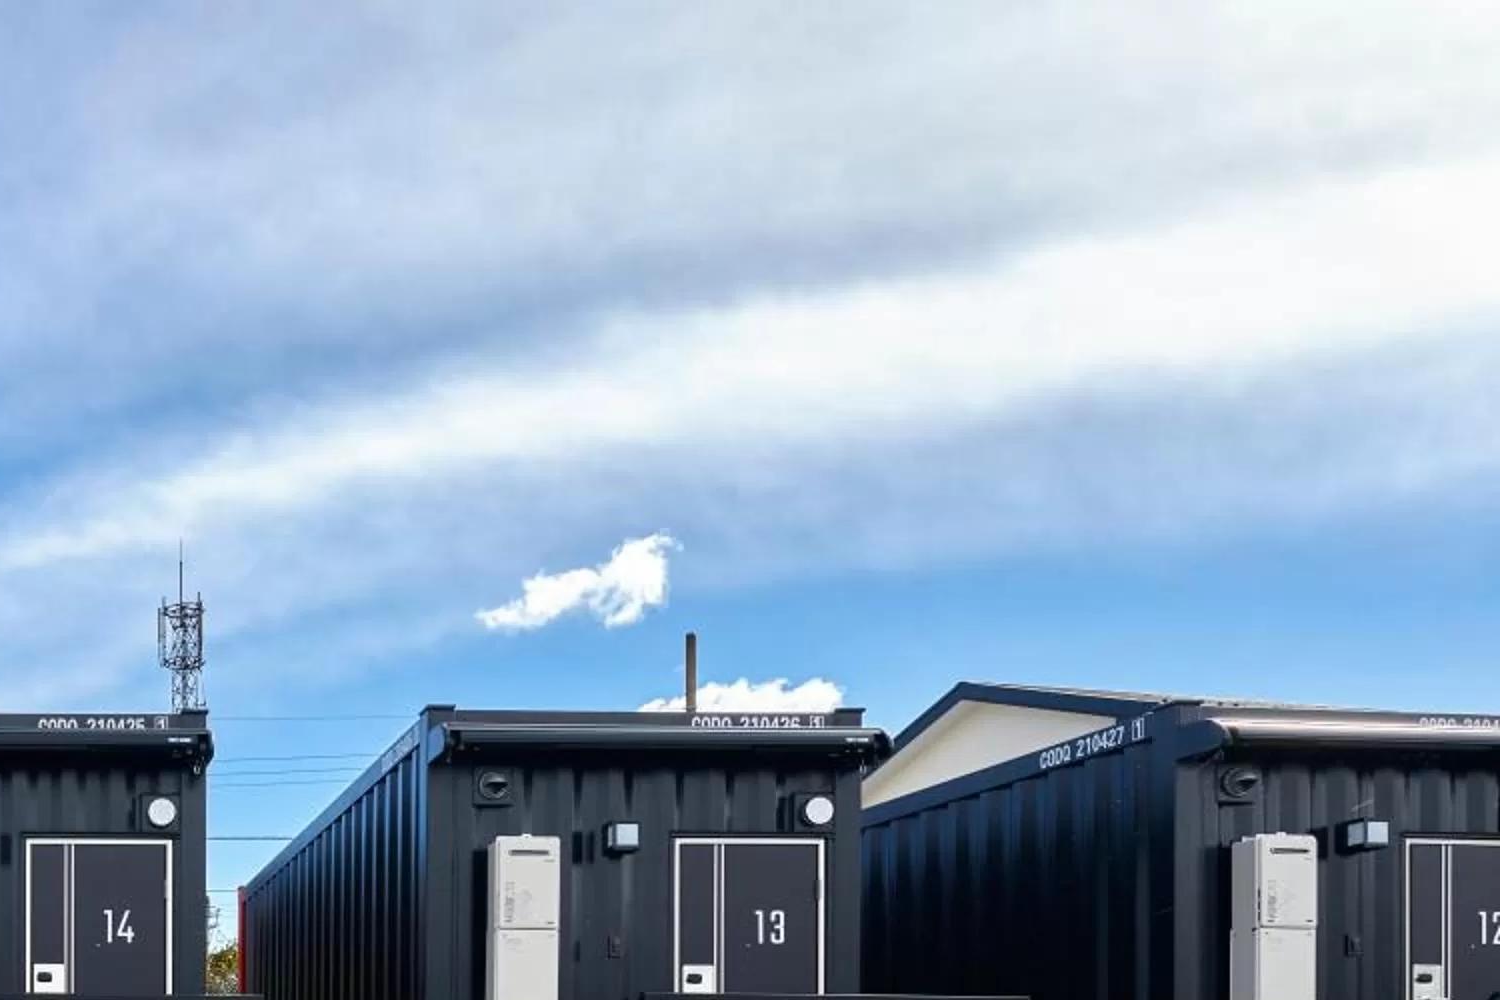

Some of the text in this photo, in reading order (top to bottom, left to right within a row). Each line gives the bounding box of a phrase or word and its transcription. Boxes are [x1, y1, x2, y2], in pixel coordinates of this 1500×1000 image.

[1076, 725, 1125, 756] 210427
[103, 909, 135, 944] 14
[754, 910, 785, 944] 13
